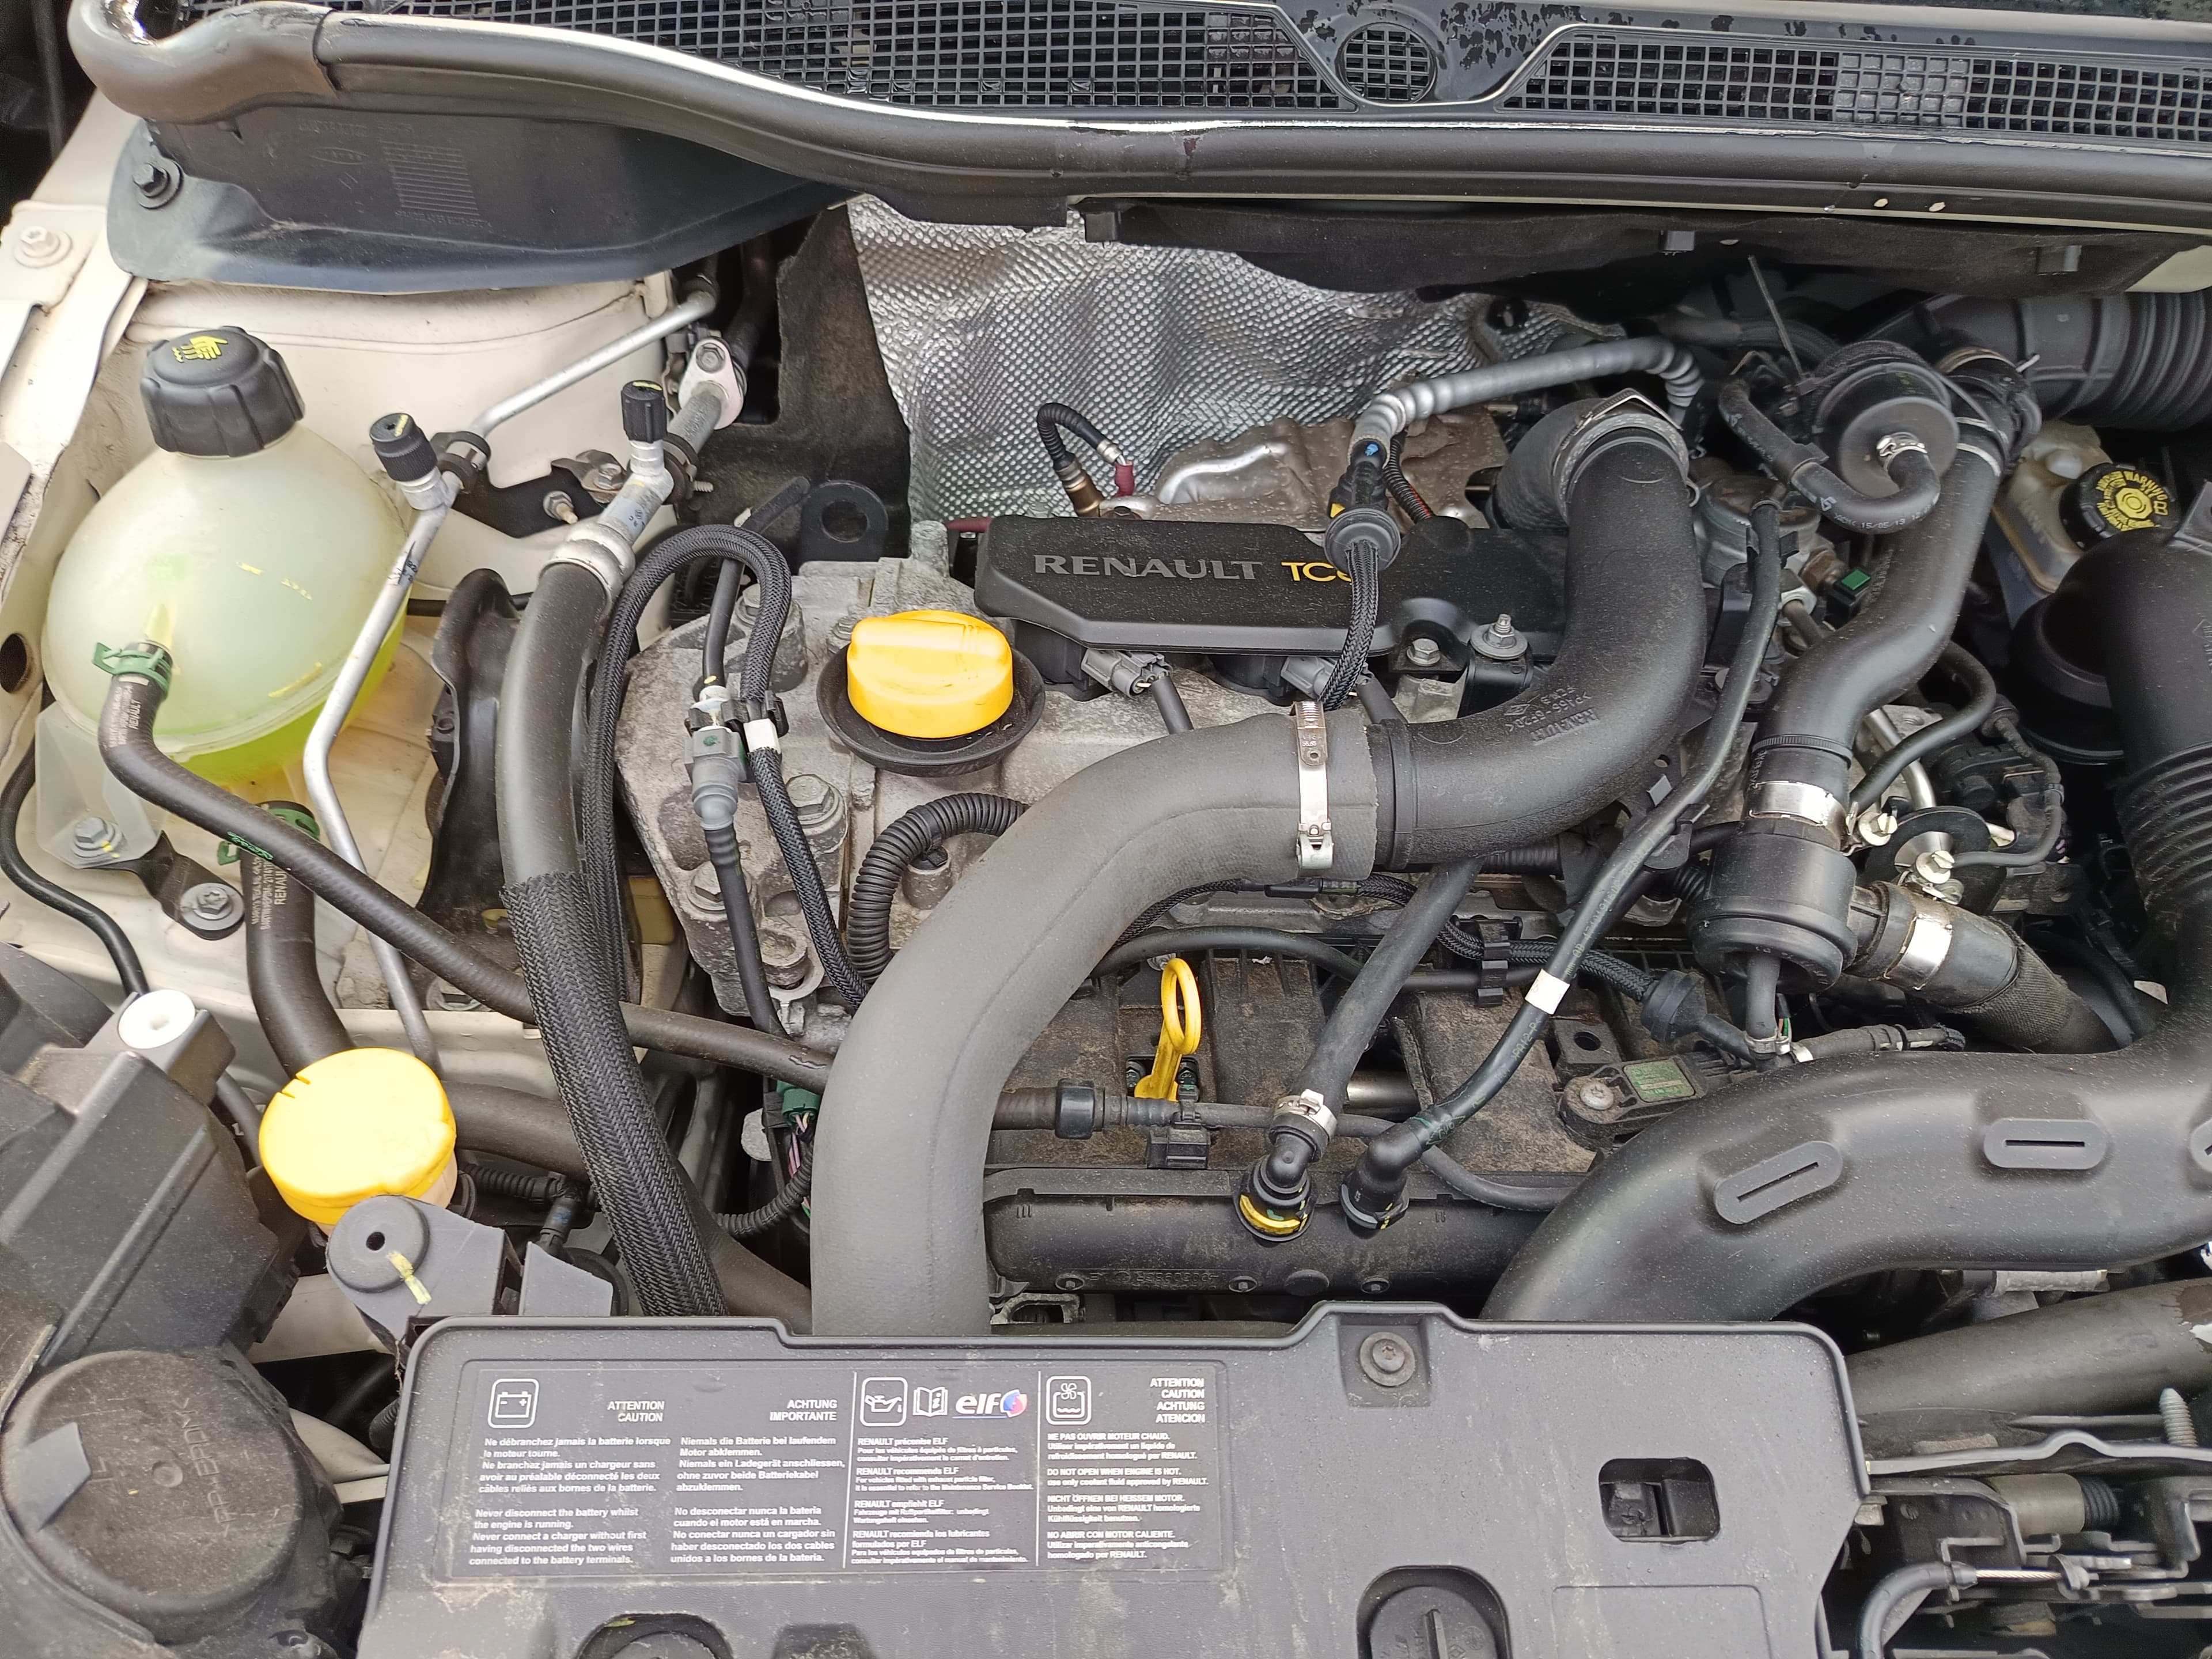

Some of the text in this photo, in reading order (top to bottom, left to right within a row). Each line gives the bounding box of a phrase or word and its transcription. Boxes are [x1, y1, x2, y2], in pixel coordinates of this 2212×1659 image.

[2124, 471, 2168, 501] WARNING
[1034, 555, 1262, 581] RENAULT
[128, 699, 142, 729] RENAULT
[1529, 707, 1600, 744] RENAULT
[275, 871, 287, 905] RENAU
[1150, 1378, 1203, 1387] ATTENTION
[1161, 1389, 1204, 1397] CAUTION
[607, 1401, 664, 1410] ATTENTION
[787, 1400, 836, 1408] ACHTUNG
[955, 1393, 1002, 1414] elf
[1157, 1402, 1204, 1410] ACHTUNG
[618, 1412, 662, 1421] CAUTION
[770, 1411, 836, 1420] IMPORTANTE
[554, 1438, 585, 1446] jamais
[636, 1437, 670, 1445] lorsque
[541, 1461, 572, 1469] jamais
[589, 1461, 631, 1469] chargeur
[782, 1459, 845, 1467] anschliessen,
[479, 1484, 508, 1492] câbles
[575, 1509, 608, 1517] battery
[551, 1532, 588, 1541] charger
[777, 1530, 819, 1539] cargador
[470, 1545, 502, 1554] having
[551, 1556, 584, 1565] battery
